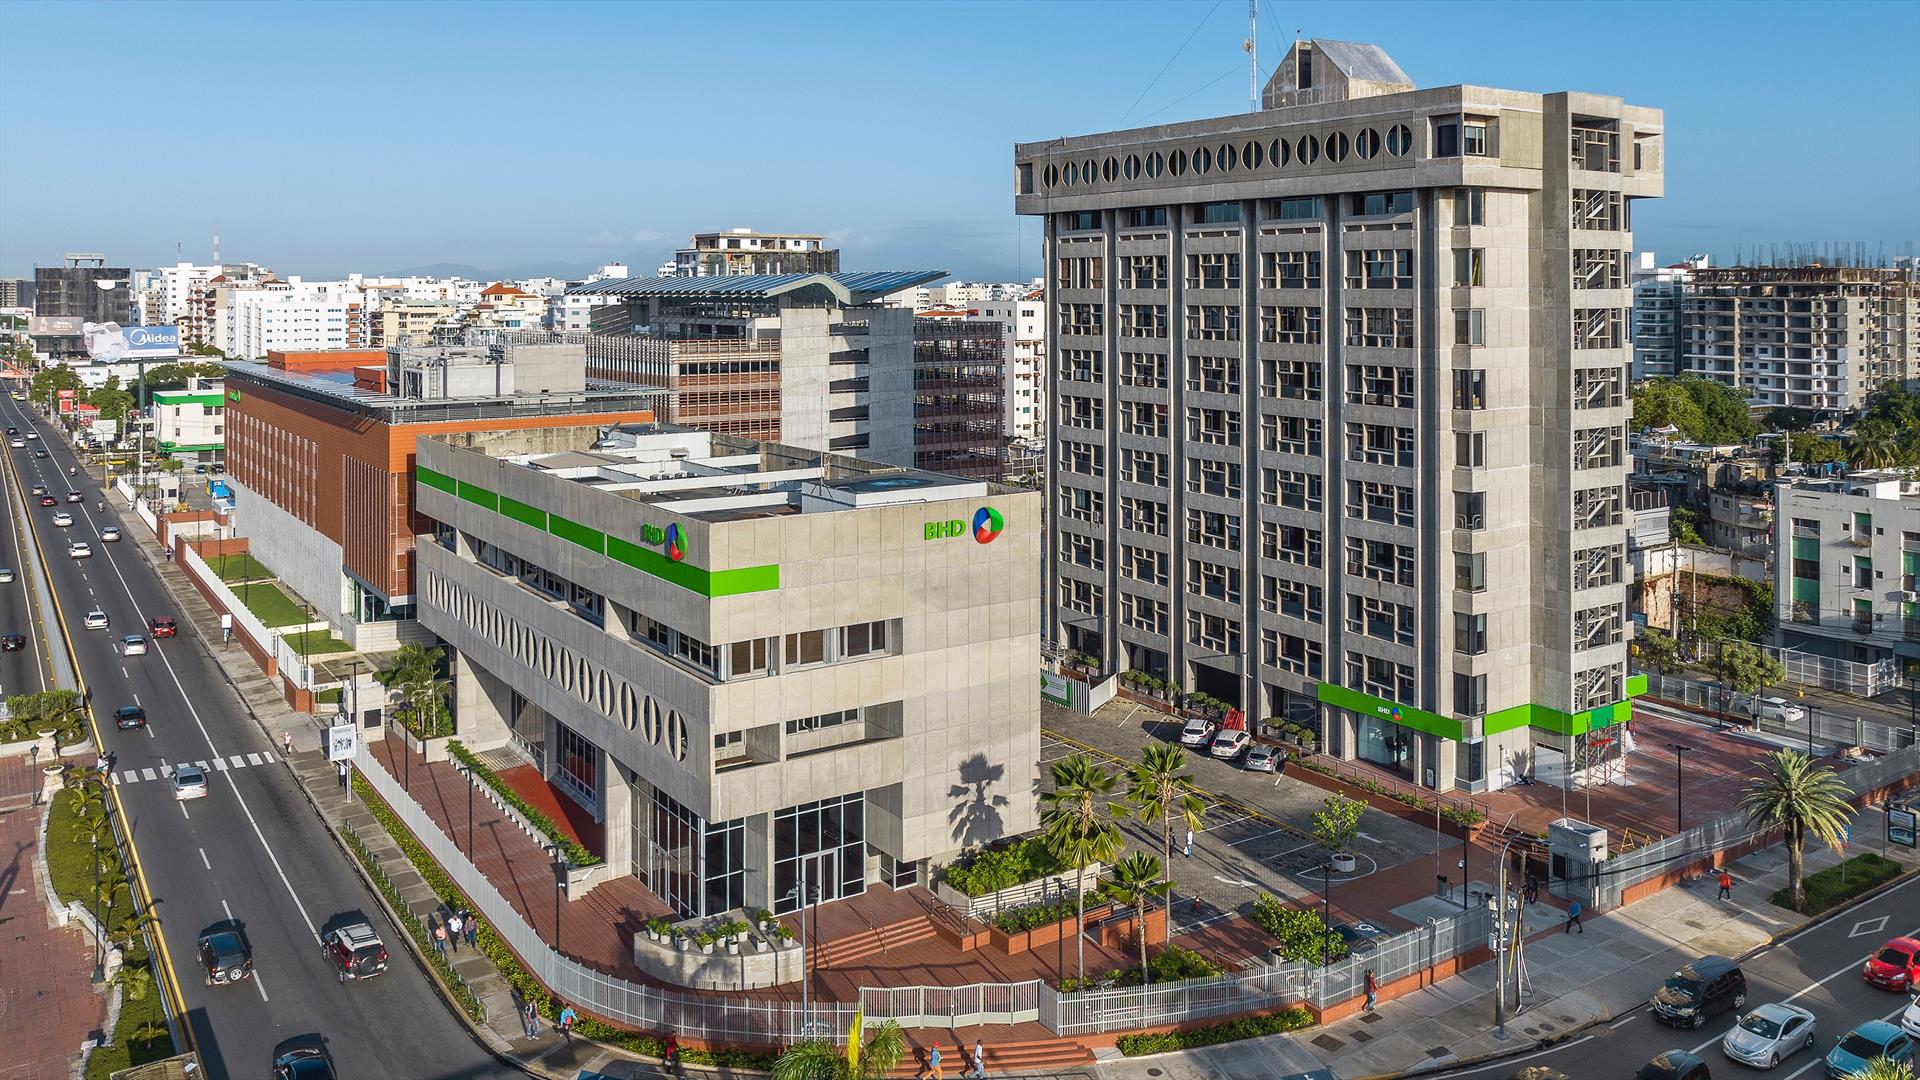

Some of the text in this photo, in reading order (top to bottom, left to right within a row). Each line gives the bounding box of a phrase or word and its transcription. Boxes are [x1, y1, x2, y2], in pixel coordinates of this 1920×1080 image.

[135, 331, 176, 344] Midea
[641, 523, 665, 545] BHD
[924, 519, 967, 541] BHD
[1377, 705, 1390, 715] BHD
